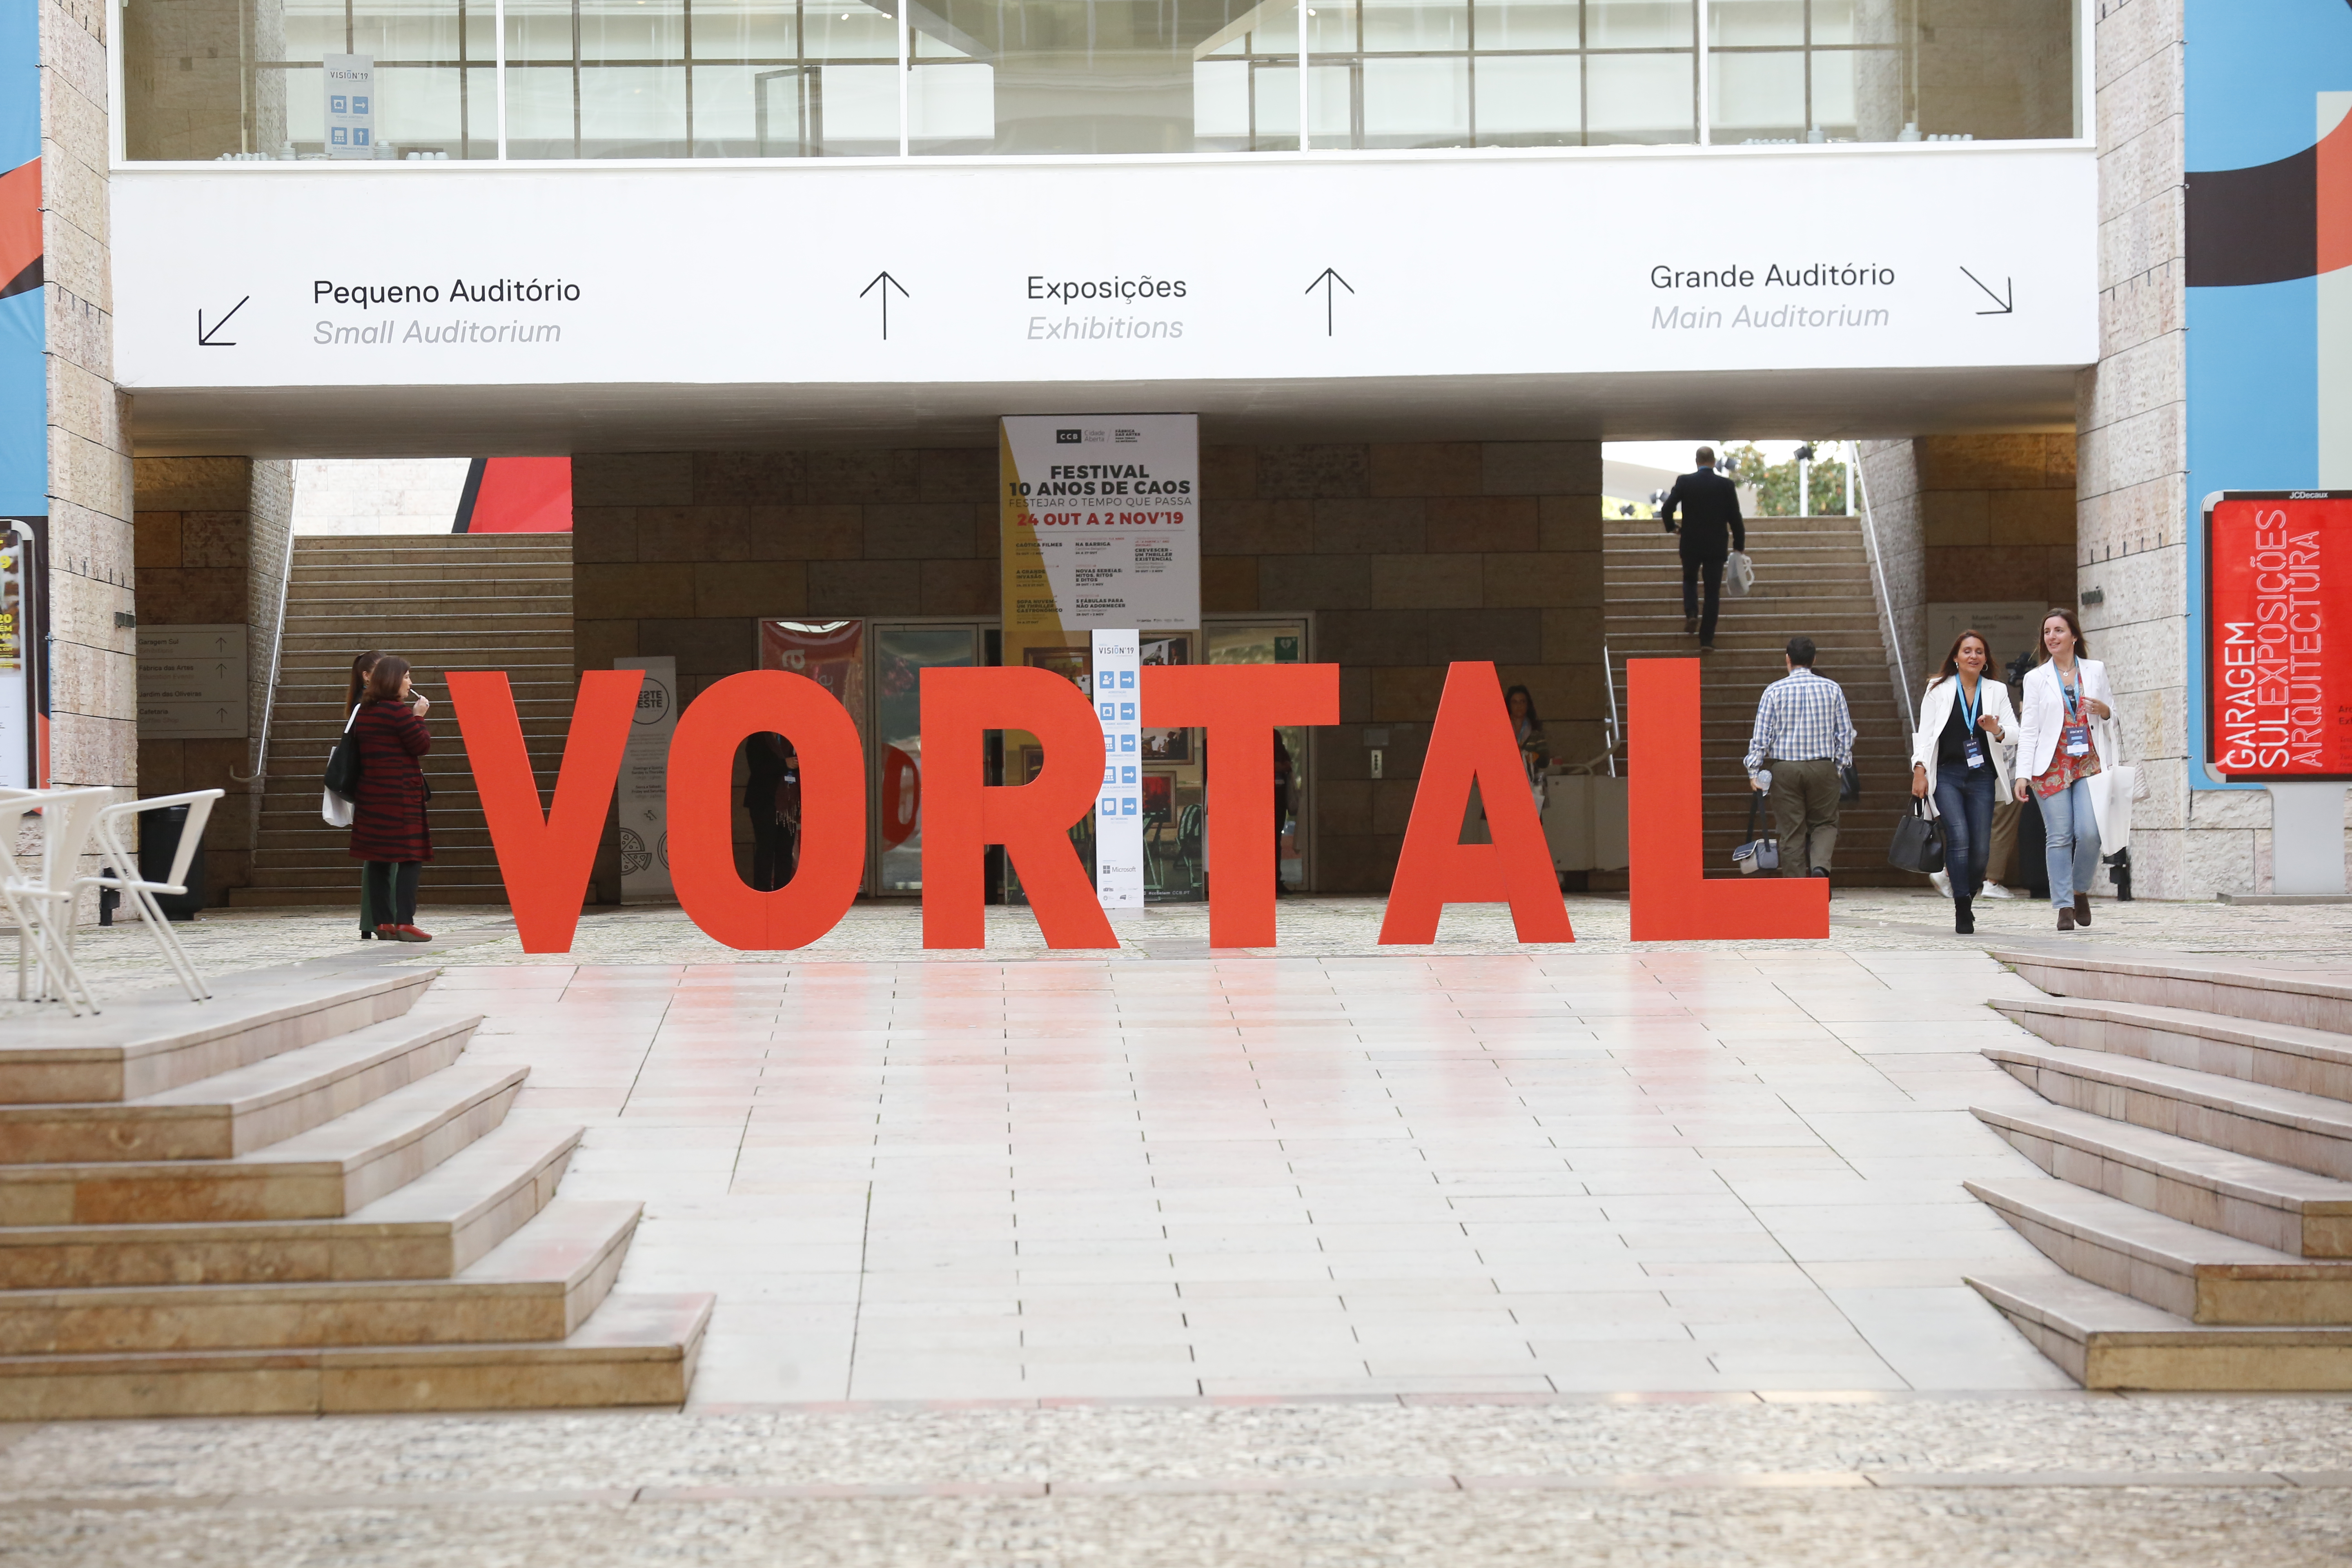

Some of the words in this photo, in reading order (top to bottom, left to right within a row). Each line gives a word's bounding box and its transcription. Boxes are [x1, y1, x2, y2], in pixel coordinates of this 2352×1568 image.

[1651, 264, 1755, 289] Grande
[1764, 262, 1895, 287] Auditório
[314, 280, 439, 310] Pequeno
[449, 278, 580, 303] Auditório
[1028, 275, 1187, 305] Exposições
[1027, 316, 1183, 339] Exhibitions
[1652, 306, 1722, 329] Main
[1732, 304, 1889, 327] Auditorium
[314, 320, 394, 345] Small
[402, 320, 561, 343] Auditorium
[1051, 464, 1149, 479] FESTIVAL
[1009, 482, 1032, 497] 10
[1037, 481, 1096, 496] ANOS
[1101, 481, 1129, 495] DE
[1134, 480, 1191, 495] CAOS
[2289, 491, 2328, 499] JCDecaux
[1009, 497, 1065, 508] FESTEJAR
[1069, 497, 1078, 507] O
[1080, 497, 1121, 507] TEMPO
[1126, 497, 1151, 507] QUE
[1155, 496, 1192, 506] PASSA
[1017, 513, 1039, 526] 24
[1043, 513, 1082, 526] OUT
[1086, 513, 1099, 526] A
[1105, 512, 1115, 525] 2
[2250, 509, 2294, 705] EXPOSIÇÕES
[2288, 530, 2323, 767] ARQUITECTURA
[636, 699, 663, 708] ESTE
[2224, 621, 2256, 768] GARAGEM
[2258, 708, 2289, 768] SUL
[445, 658, 1829, 953] VORTAL
